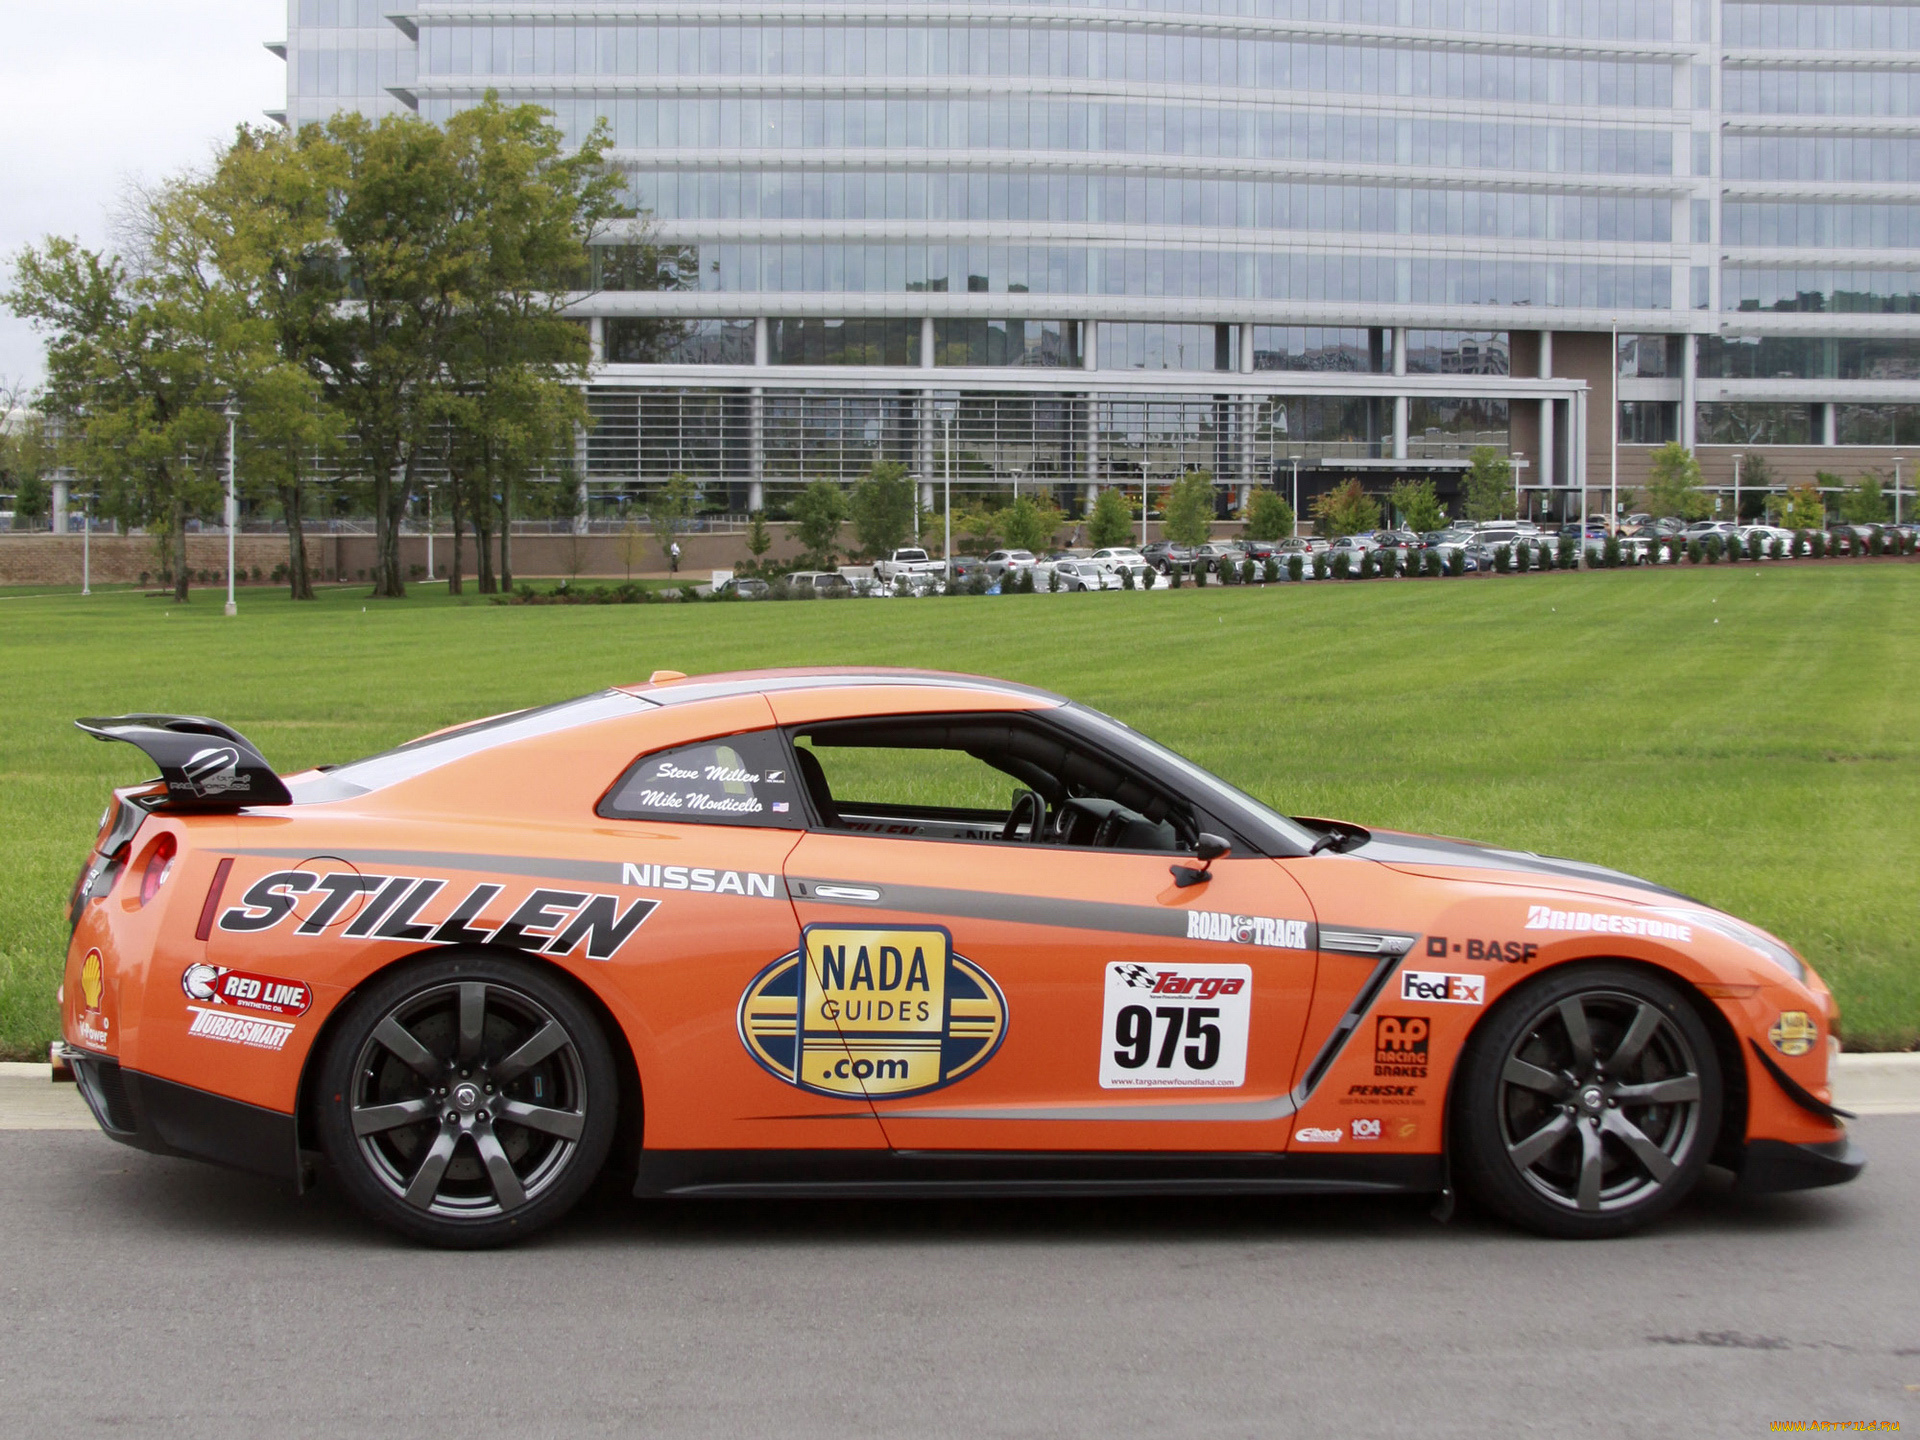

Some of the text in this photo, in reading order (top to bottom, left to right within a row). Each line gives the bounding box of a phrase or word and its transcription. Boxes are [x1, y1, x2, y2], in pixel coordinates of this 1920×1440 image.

[657, 762, 760, 783] Steve Millen
[640, 789, 763, 813] Mike Monticello
[622, 862, 776, 898] NISSAN
[218, 869, 663, 961] STILLEN
[1525, 905, 1693, 942] BRIDGESTONE
[1467, 938, 1539, 964] BASF
[822, 944, 930, 992] NADA
[224, 976, 262, 1000] RED
[1152, 971, 1246, 1000] Targa
[1404, 973, 1481, 1002] FedEx
[237, 1000, 272, 1011] SYNTHETIC
[820, 999, 930, 1022] GUIDES
[186, 1005, 296, 1047] TURBOSMART
[1114, 1004, 1221, 1070] 975
[823, 1058, 909, 1079] .com
[1374, 1065, 1428, 1078] BRAKES
[1111, 1077, 1235, 1087] www.targanewfoundland.com
[1348, 1085, 1418, 1096] PENSKE
